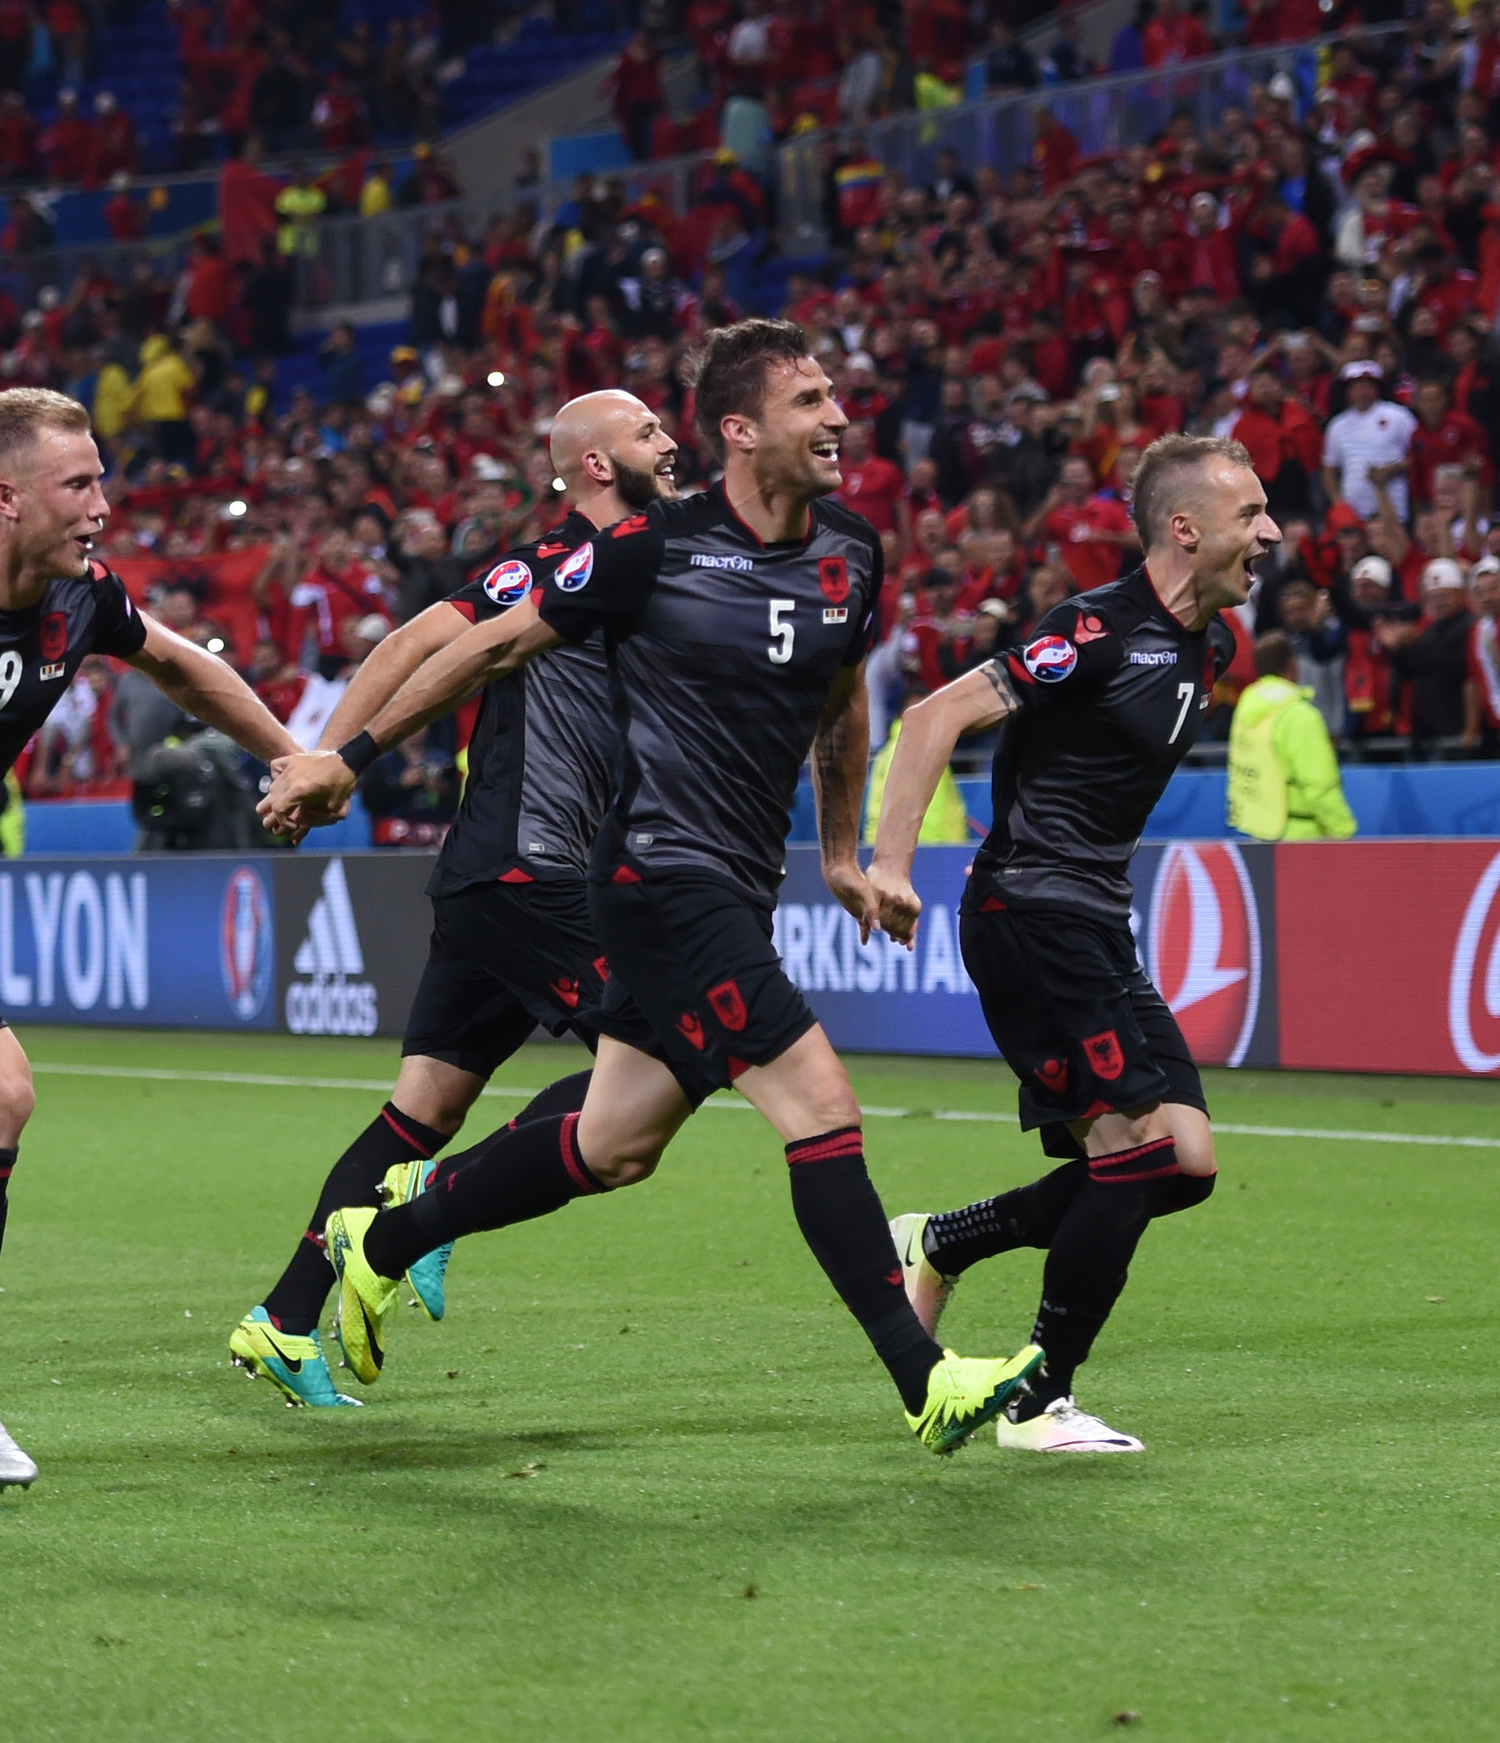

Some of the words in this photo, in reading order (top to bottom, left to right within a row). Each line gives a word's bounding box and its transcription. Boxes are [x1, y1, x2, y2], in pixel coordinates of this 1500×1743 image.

[689, 553, 754, 571] macron
[767, 599, 796, 665] 5
[1130, 651, 1178, 664] macron
[1167, 682, 1195, 745] 7
[285, 973, 379, 1038] adidas
